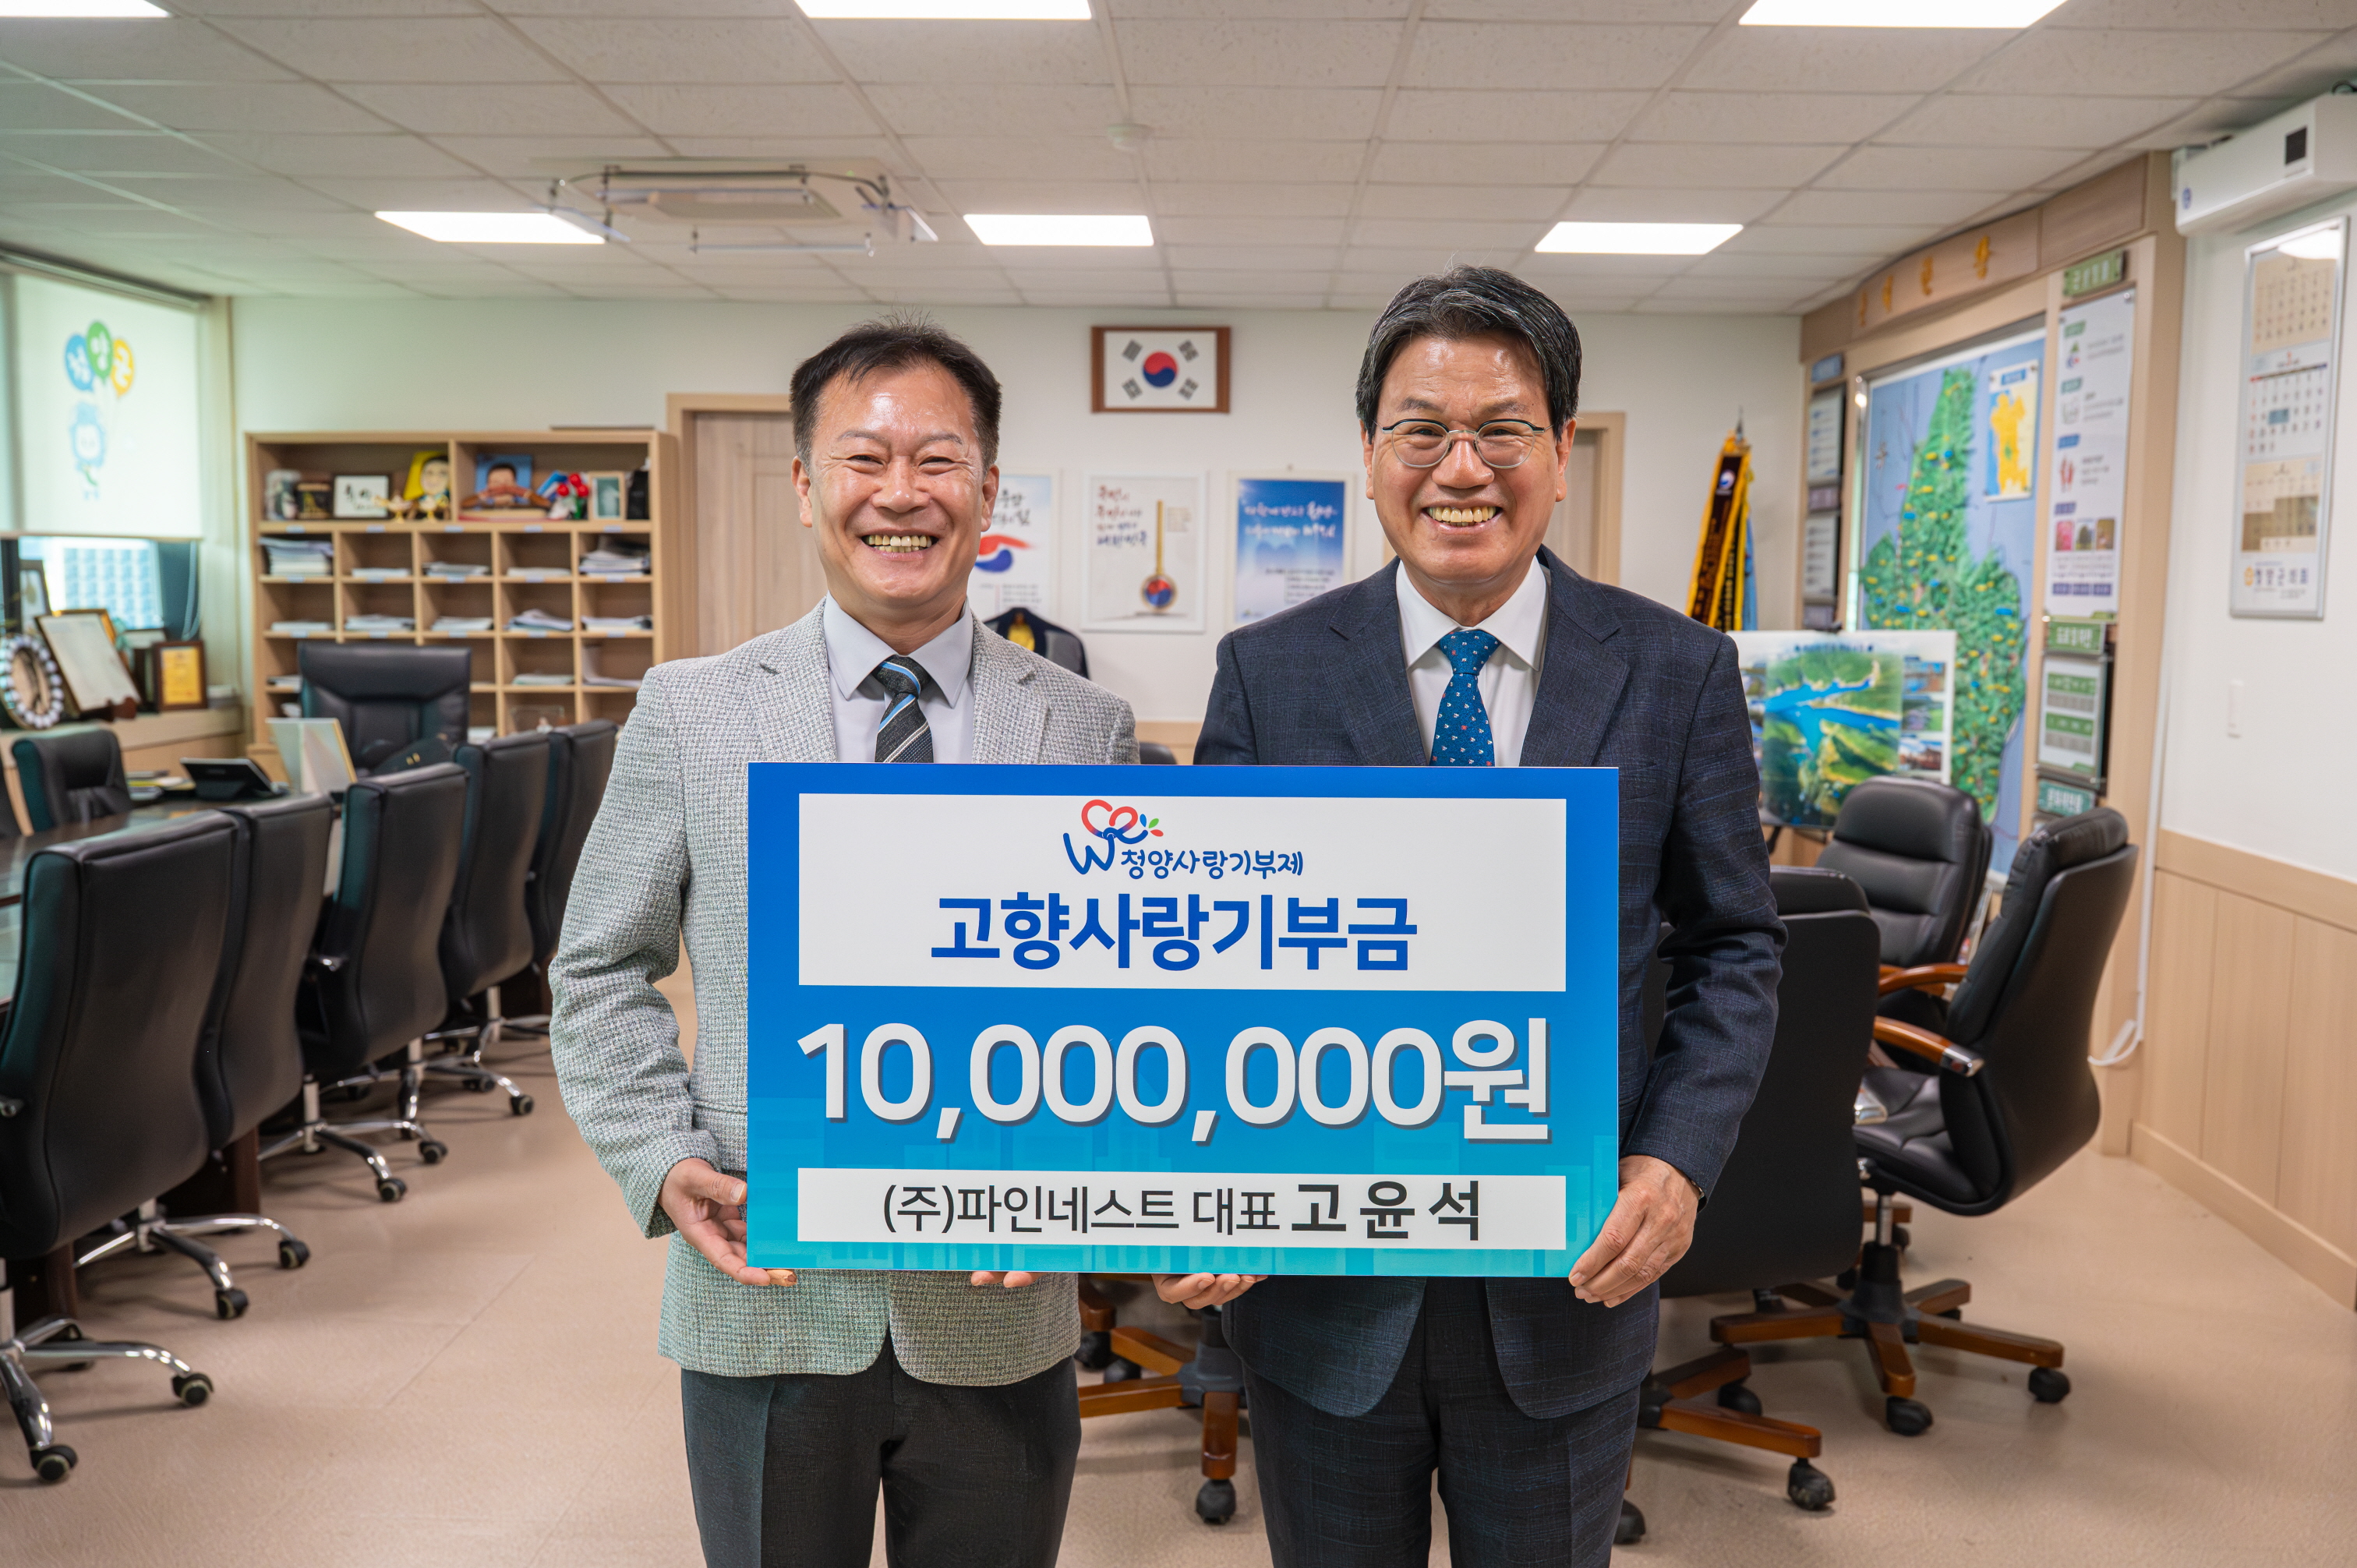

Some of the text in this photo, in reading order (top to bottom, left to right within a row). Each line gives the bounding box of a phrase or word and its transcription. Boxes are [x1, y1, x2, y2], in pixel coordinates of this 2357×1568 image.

[1120, 849, 1304, 880] 청양사랑기부제
[931, 892, 1418, 972] 고향사랑기부금
[797, 1017, 1551, 1143] 10,000,000원
[884, 1184, 1179, 1234] (주)파인네스트
[1193, 1188, 1281, 1237] 대표
